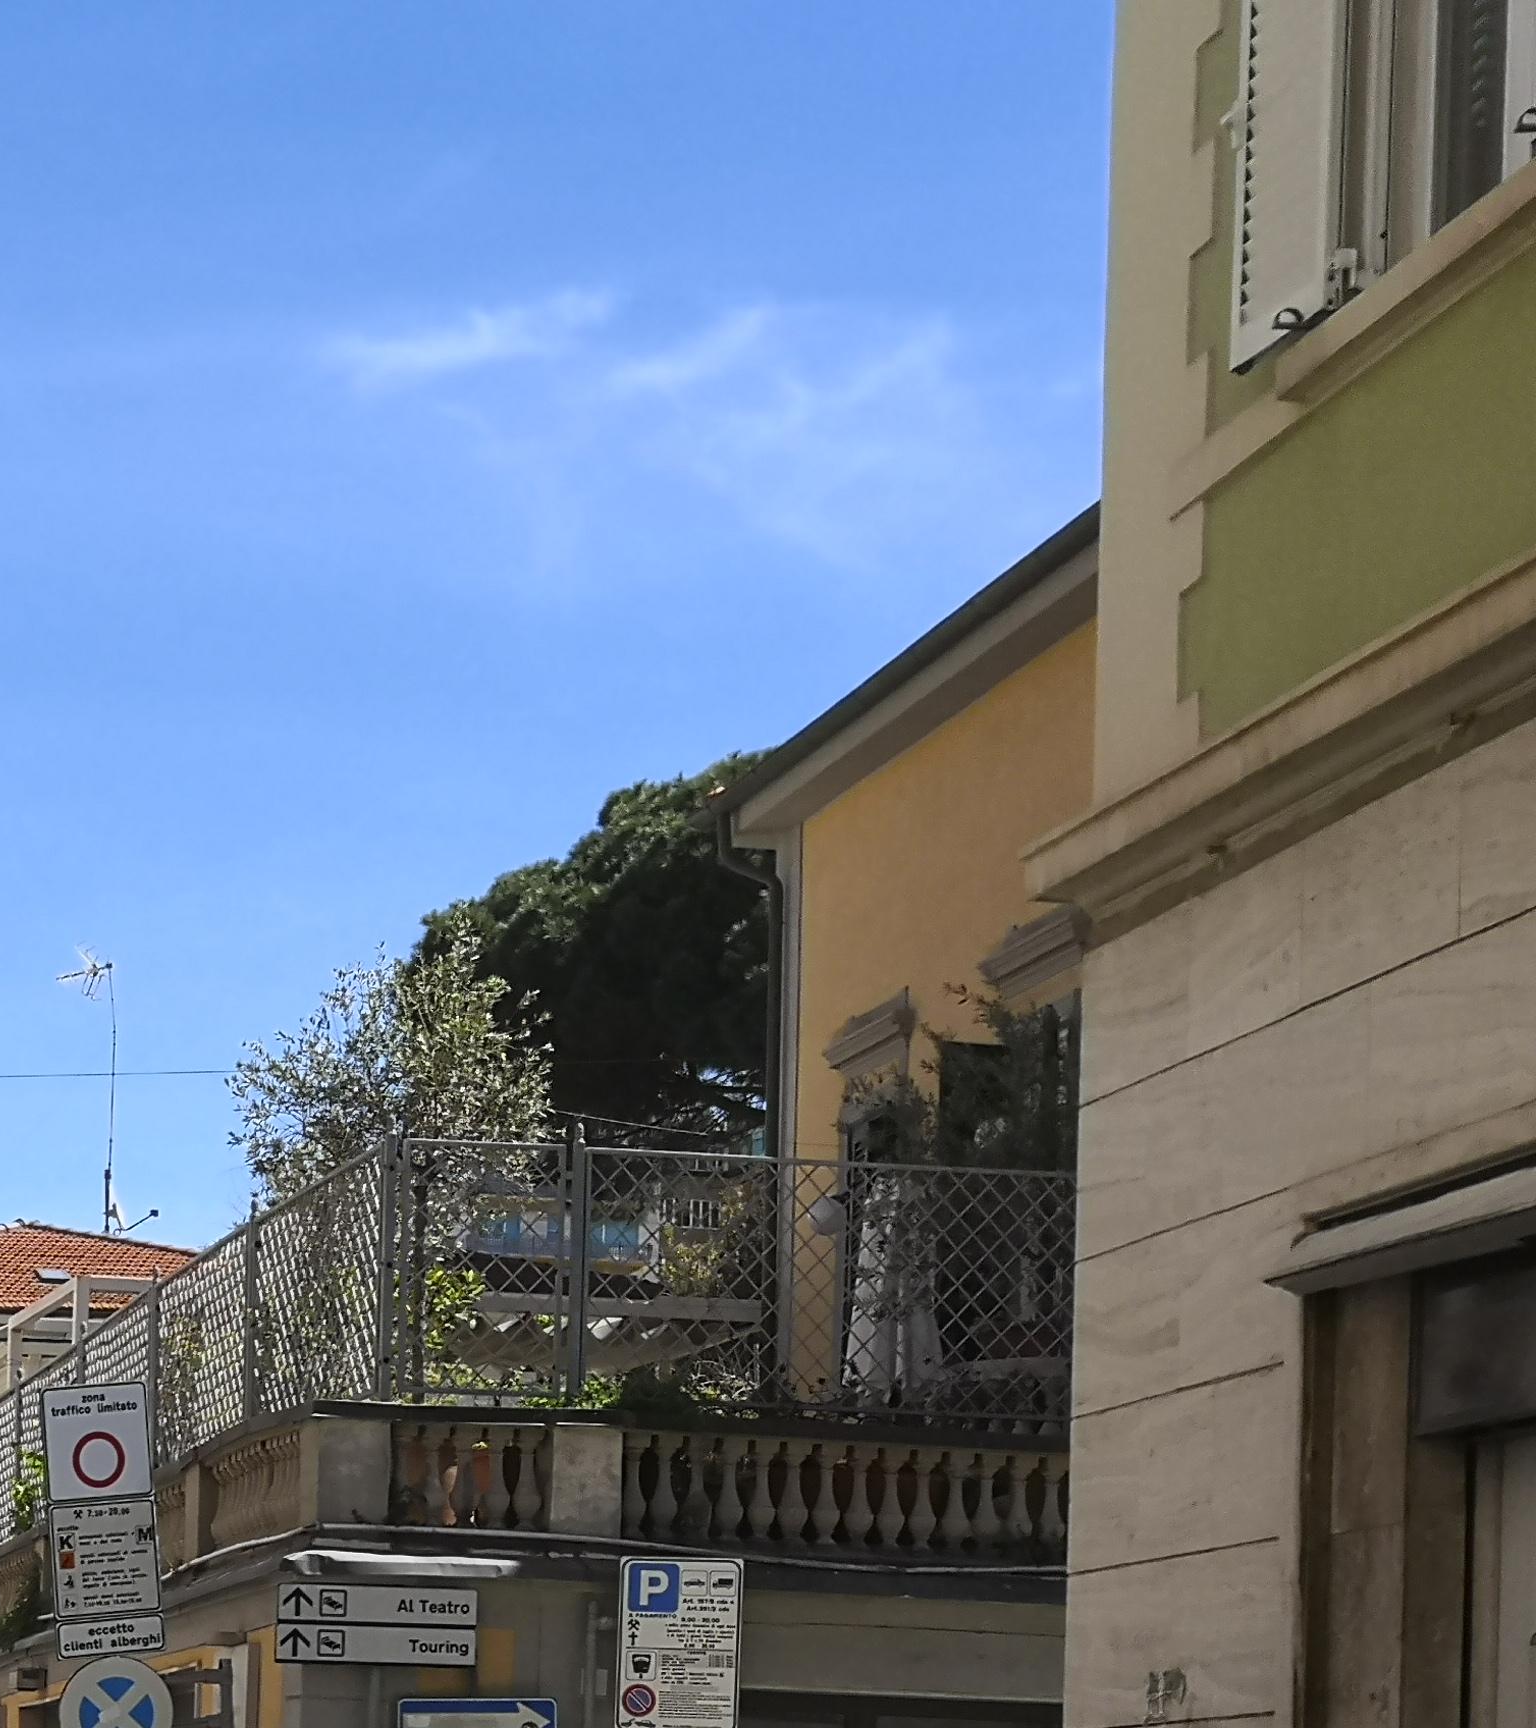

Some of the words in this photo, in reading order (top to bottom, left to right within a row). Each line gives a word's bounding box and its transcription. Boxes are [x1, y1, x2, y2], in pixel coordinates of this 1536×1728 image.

[81, 1393, 106, 1403] zona
[50, 1405, 91, 1417] traffico
[97, 1400, 138, 1413] limitato
[639, 1569, 669, 1606] P
[396, 1598, 414, 1613] Al
[419, 1600, 470, 1615] Teatro
[88, 1623, 135, 1636] eccetto
[63, 1638, 103, 1652] clienti
[110, 1632, 161, 1648] alberghi
[409, 1639, 470, 1656] Touring
